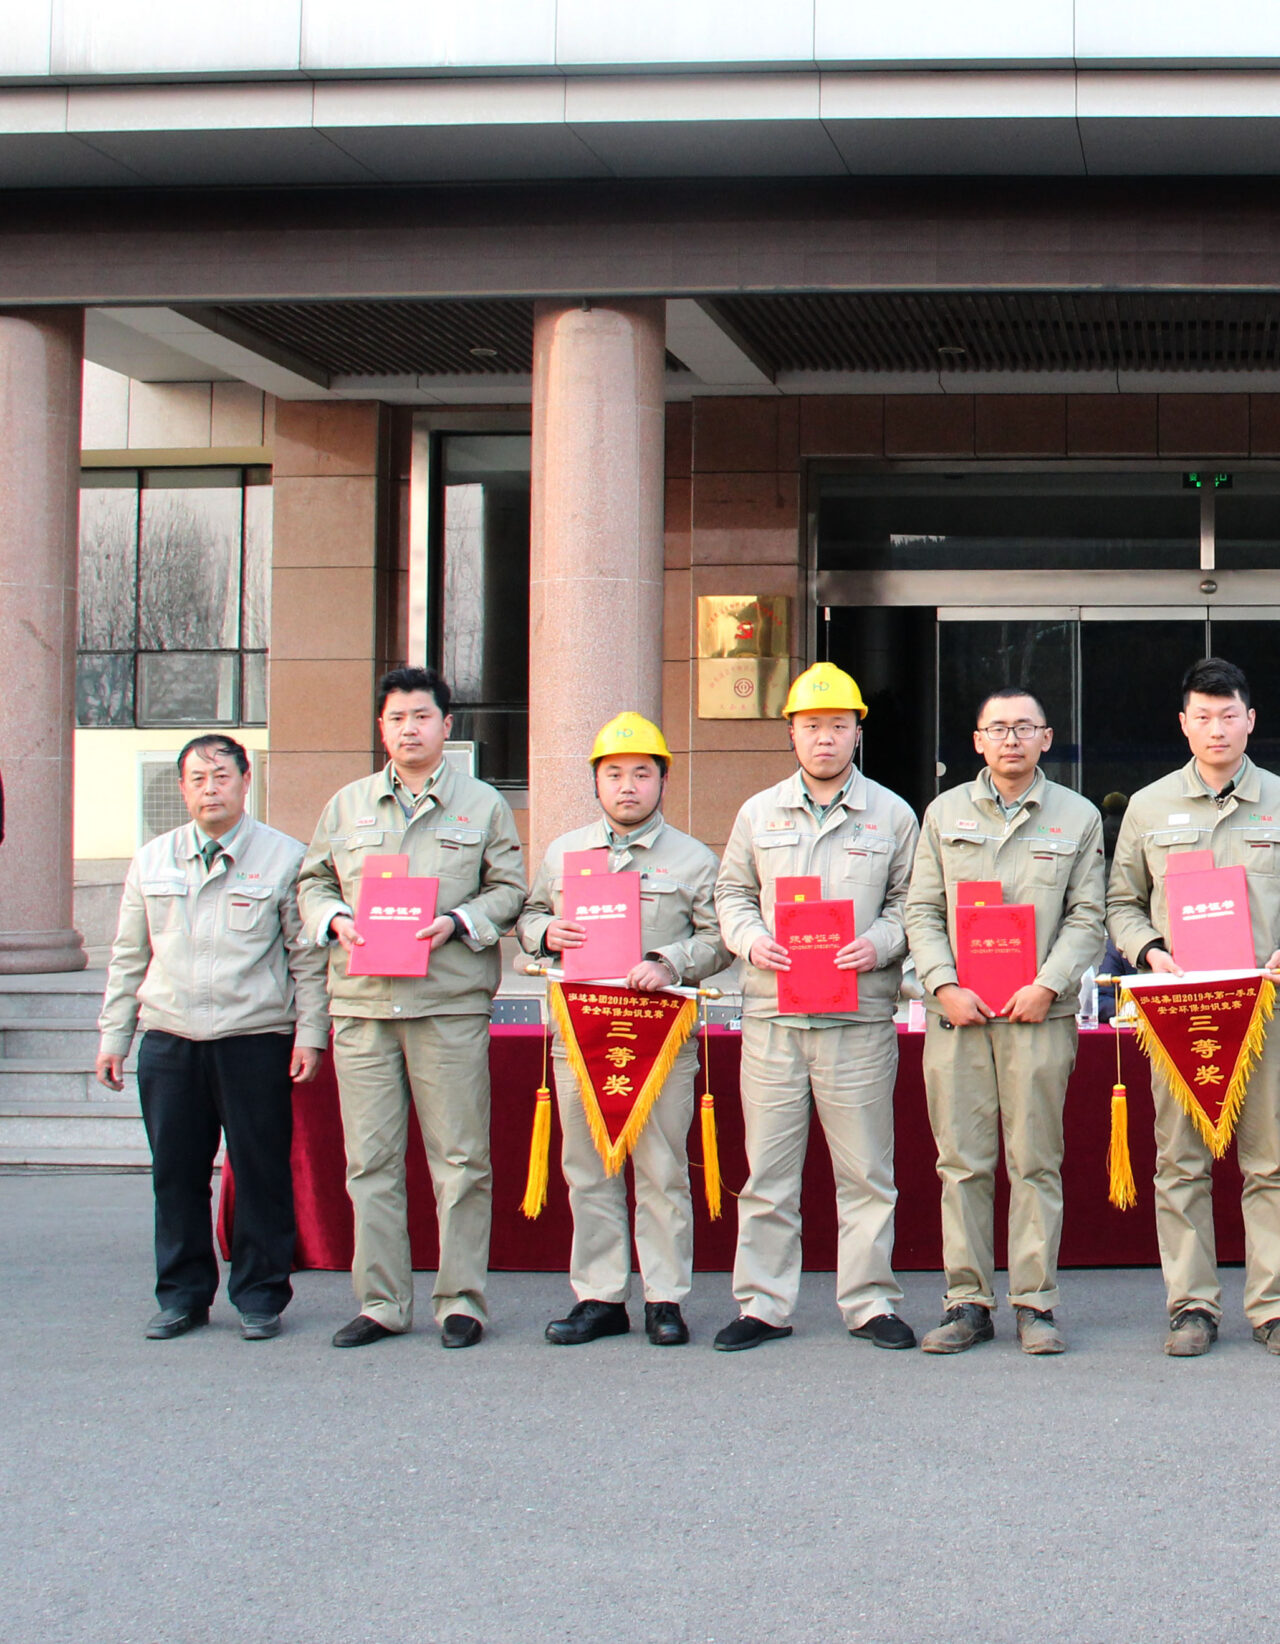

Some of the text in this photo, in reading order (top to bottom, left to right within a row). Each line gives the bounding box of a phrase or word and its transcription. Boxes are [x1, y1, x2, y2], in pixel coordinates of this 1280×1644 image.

[581, 1005, 665, 1019] 安全环保知识竞赛
[1157, 1000, 1242, 1015] 安全环保知识竞赛
[602, 1020, 639, 1097] 三等奖
[1188, 1014, 1225, 1086] 三等奖
